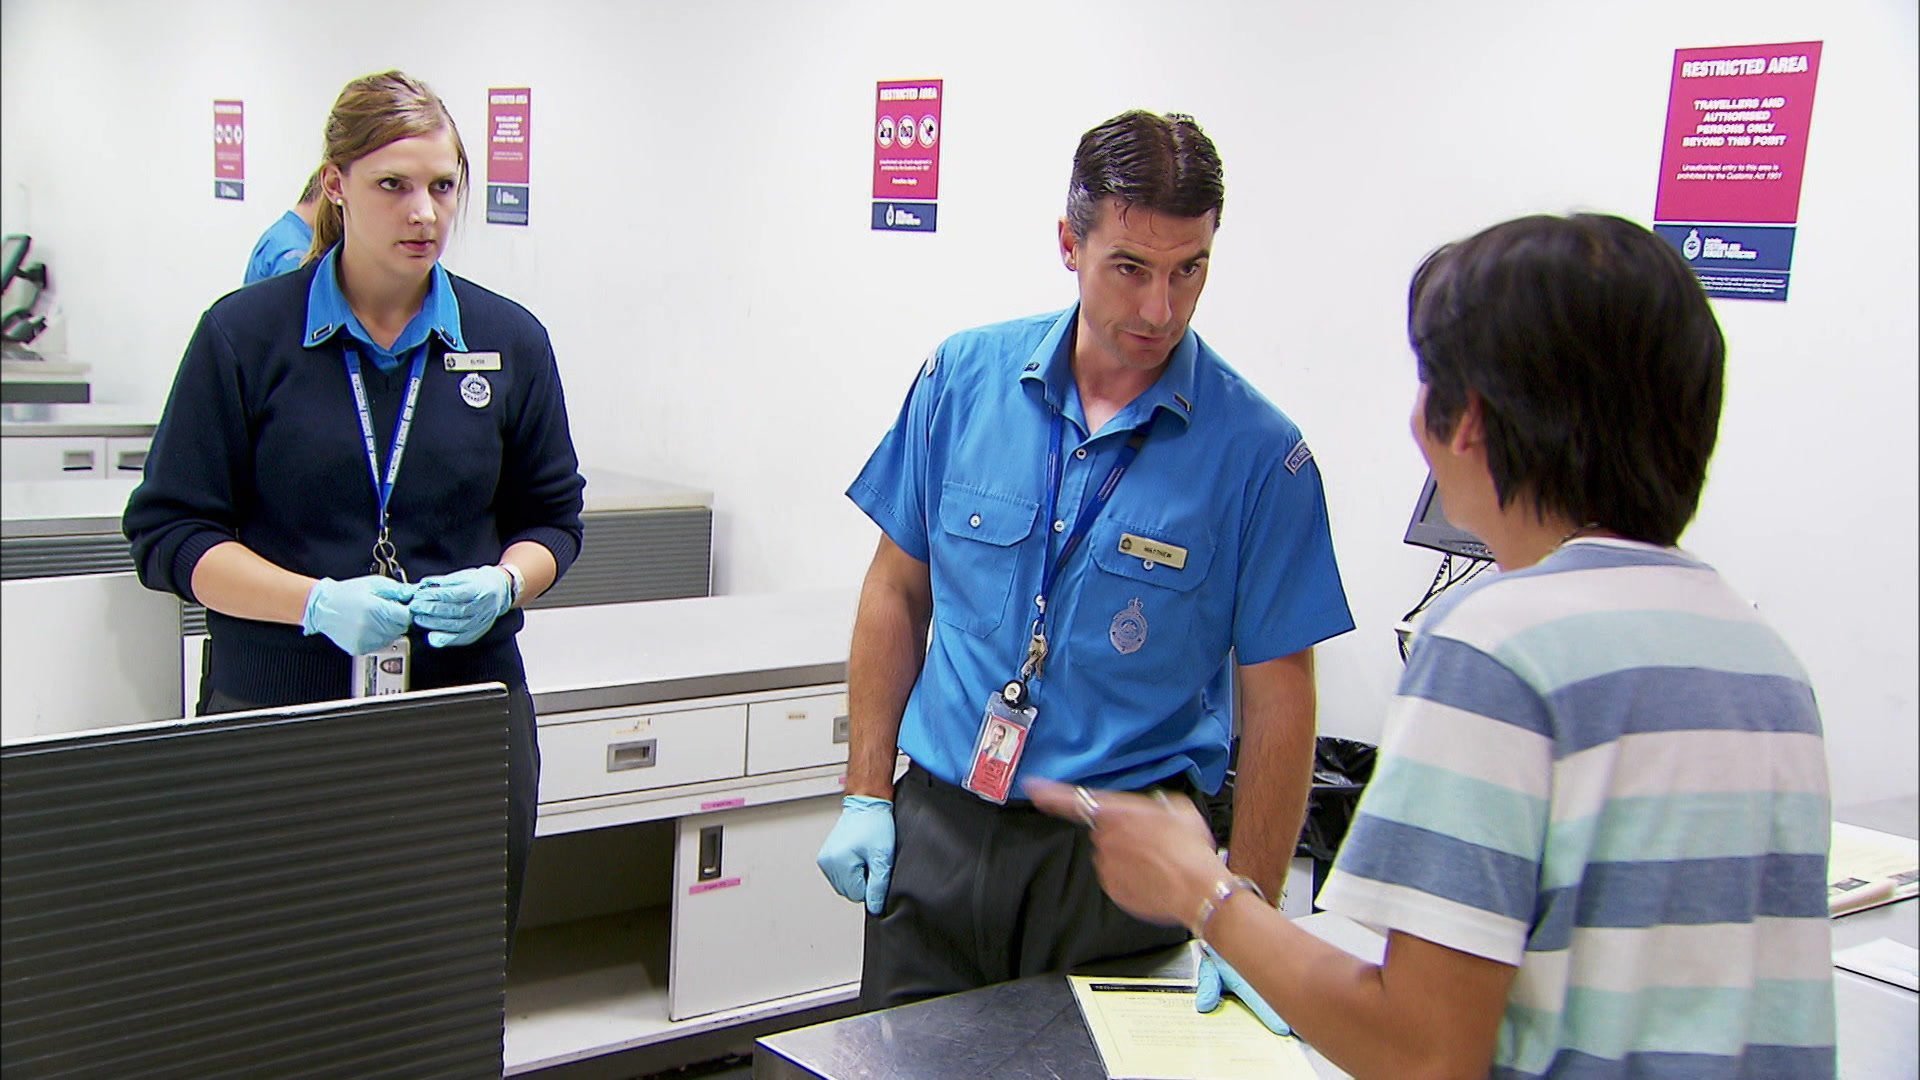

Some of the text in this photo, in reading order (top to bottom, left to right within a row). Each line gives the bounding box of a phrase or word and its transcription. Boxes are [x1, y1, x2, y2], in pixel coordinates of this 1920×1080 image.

[1681, 56, 1808, 78] RESTRICTED AREA
[1694, 97, 1785, 110] TRAVELLERS AND
[1703, 111, 1771, 122] AUTHORISED
[1696, 123, 1776, 134] PERSONS ONLY
[1682, 135, 1787, 147] BEYOND THIS POINT
[1707, 173, 1714, 181] by
[1726, 172, 1753, 180] Customs
